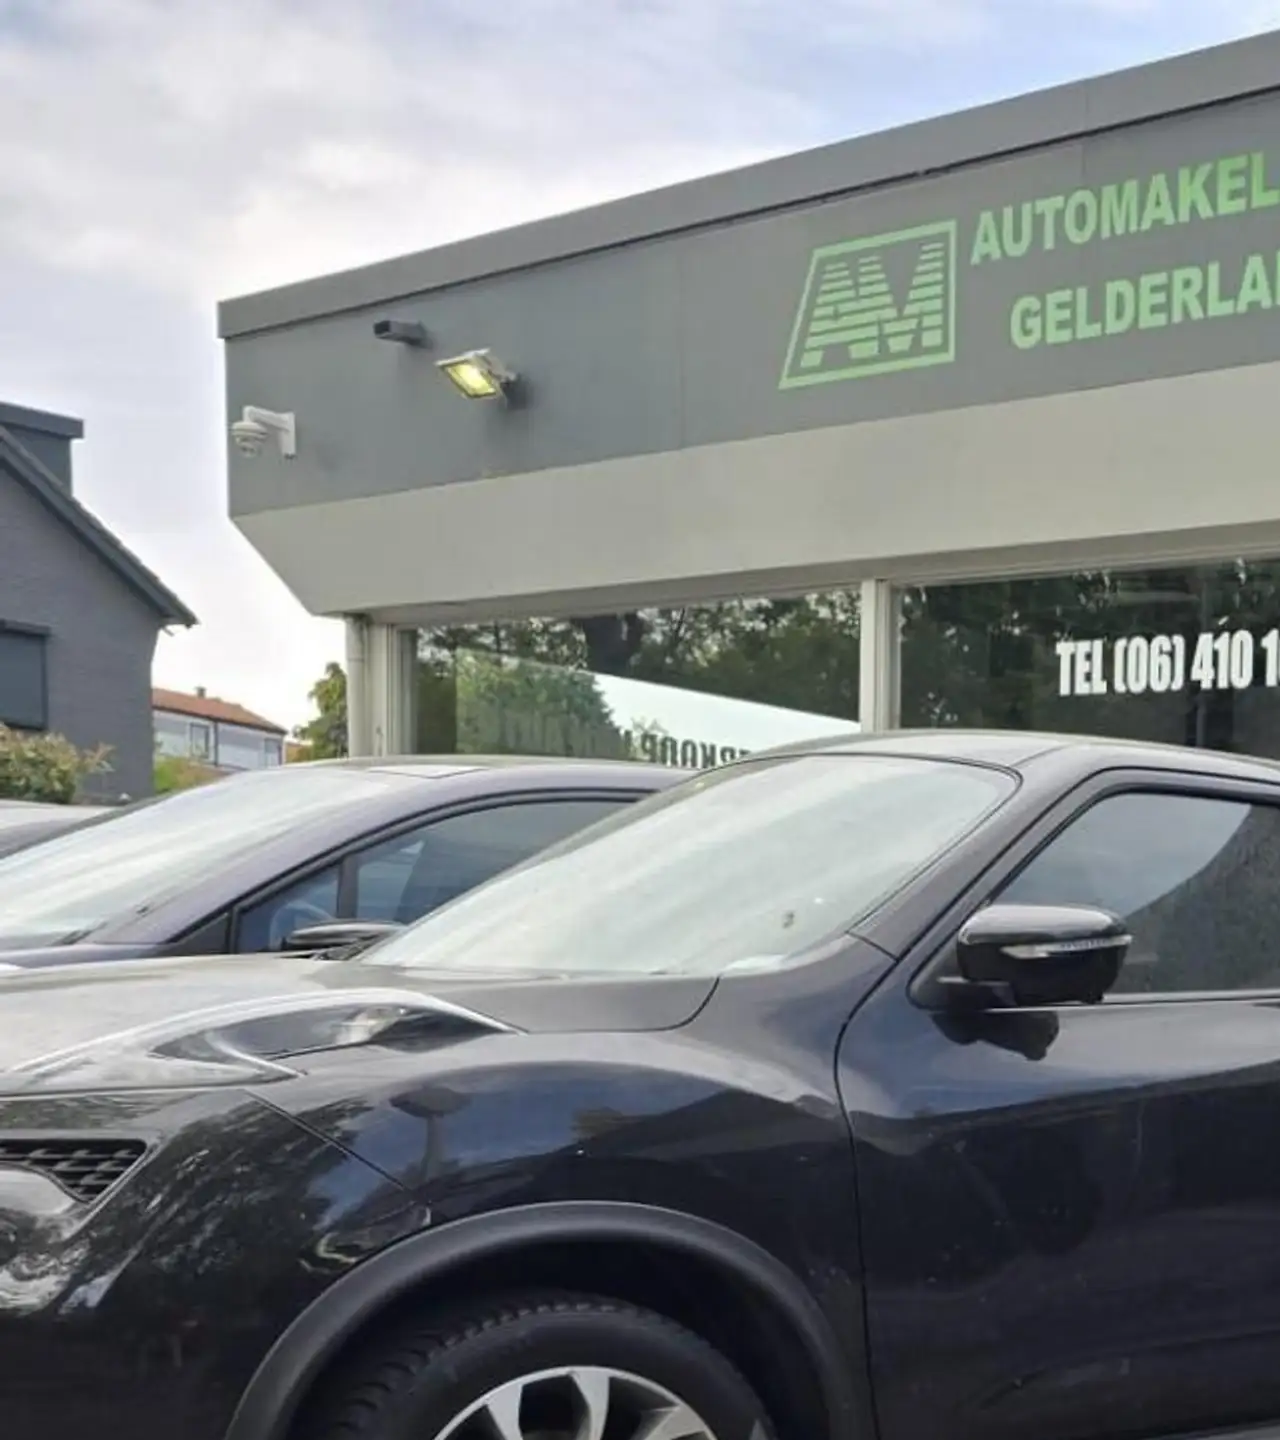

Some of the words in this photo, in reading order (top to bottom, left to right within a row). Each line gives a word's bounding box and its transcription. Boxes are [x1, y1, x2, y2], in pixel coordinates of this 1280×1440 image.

[1056, 639, 1108, 697] TEL
[1114, 634, 1186, 693] (06)
[1191, 629, 1254, 690] 410
